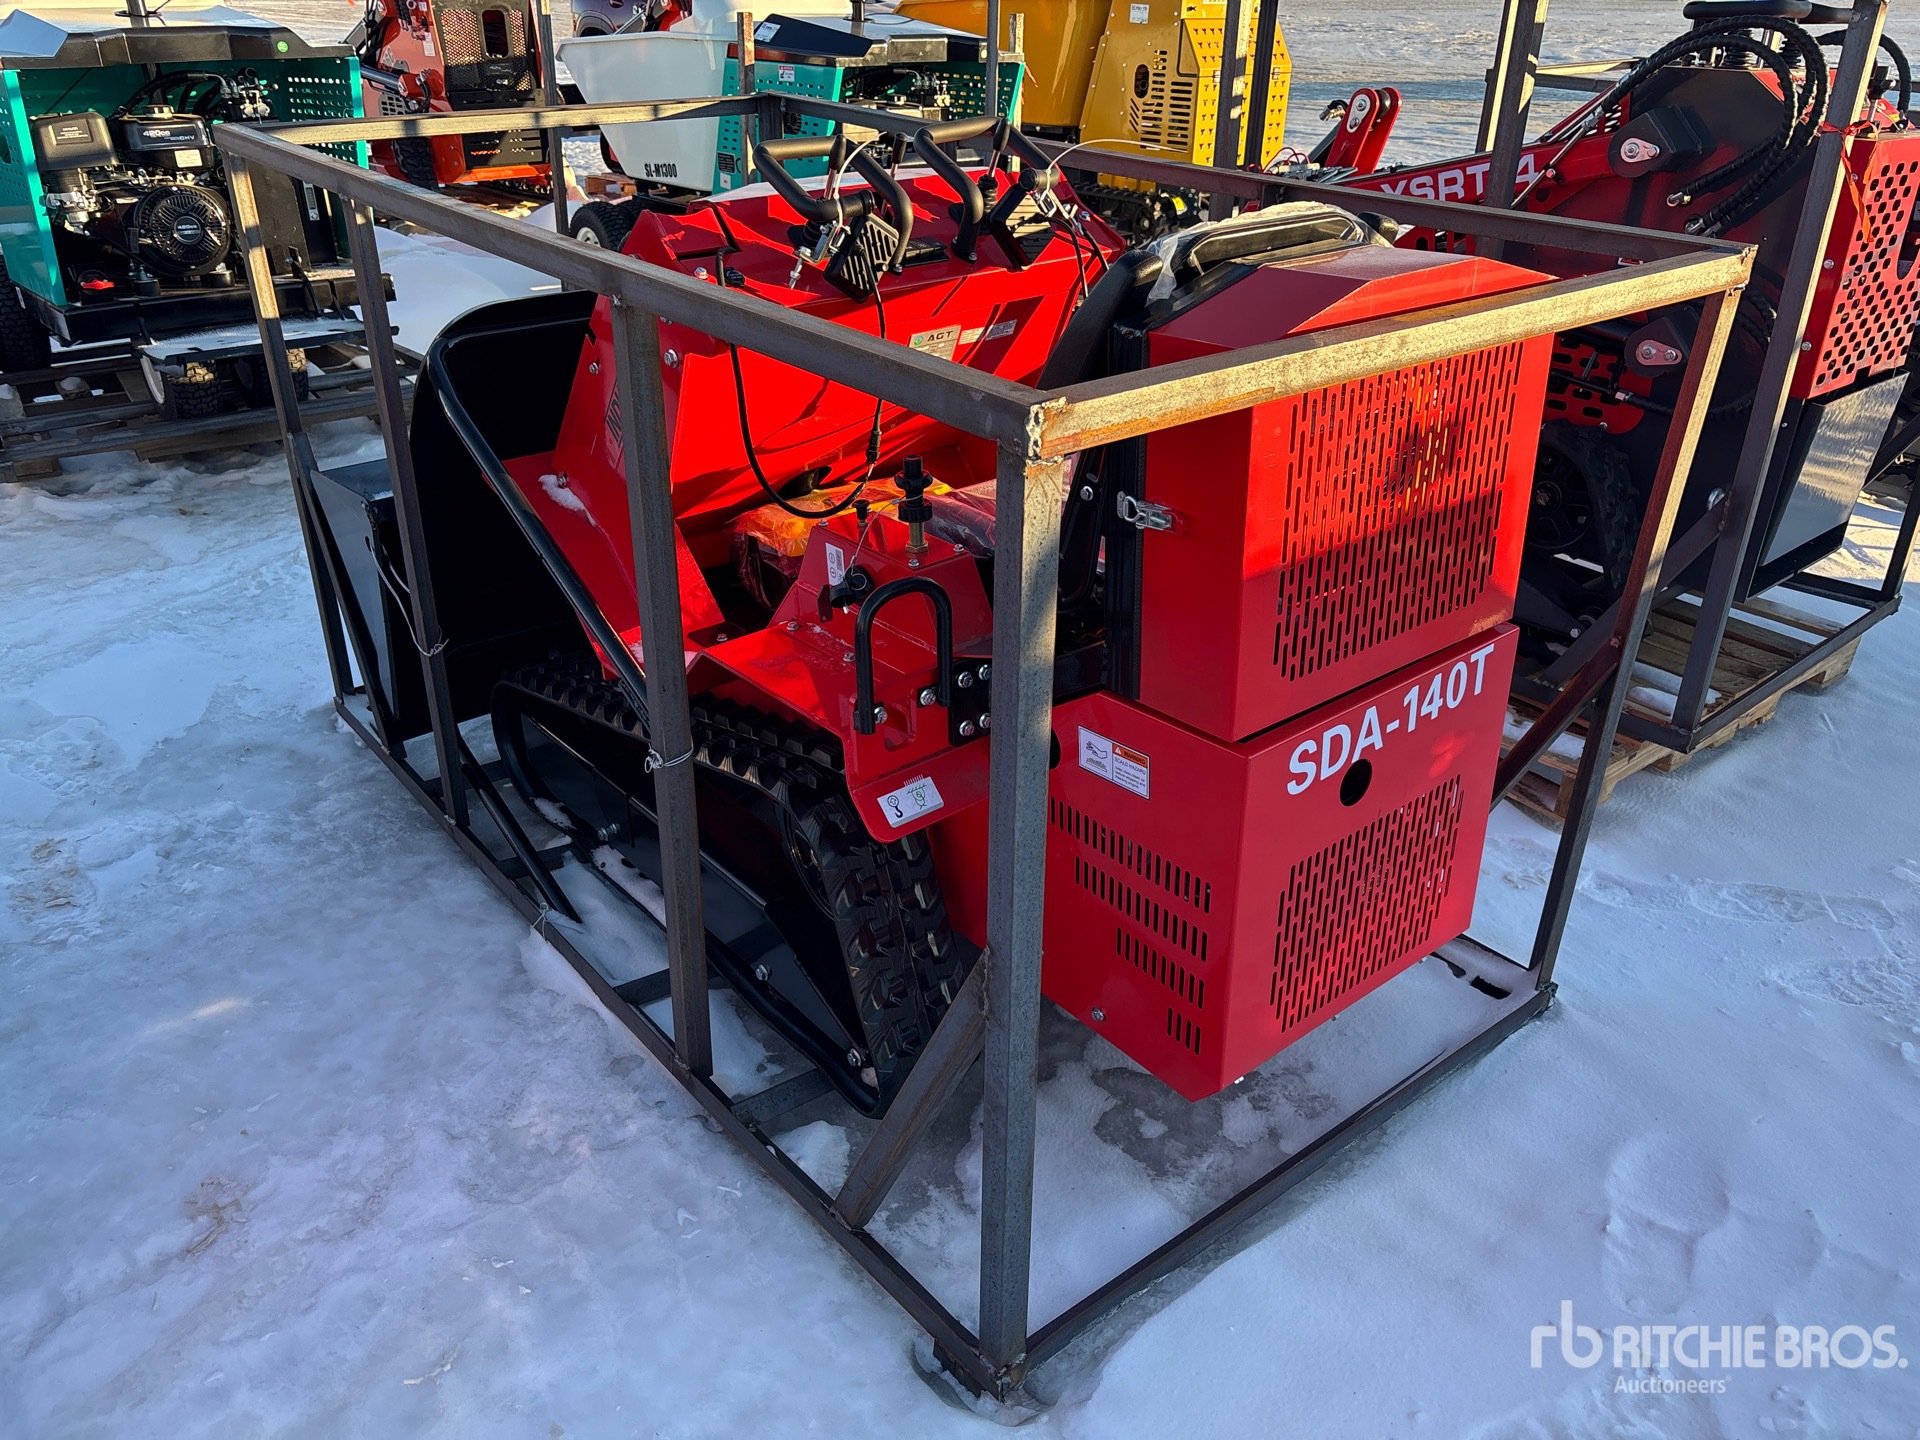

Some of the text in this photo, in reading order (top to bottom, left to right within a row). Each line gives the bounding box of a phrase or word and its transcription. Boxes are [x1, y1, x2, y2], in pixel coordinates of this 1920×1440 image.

[644, 163, 677, 178] SL-M1300
[927, 330, 954, 342] AGT
[1287, 643, 1495, 796] SDA-140T
[1123, 751, 1146, 765] WARNING
[1129, 762, 1146, 775] HAZARD
